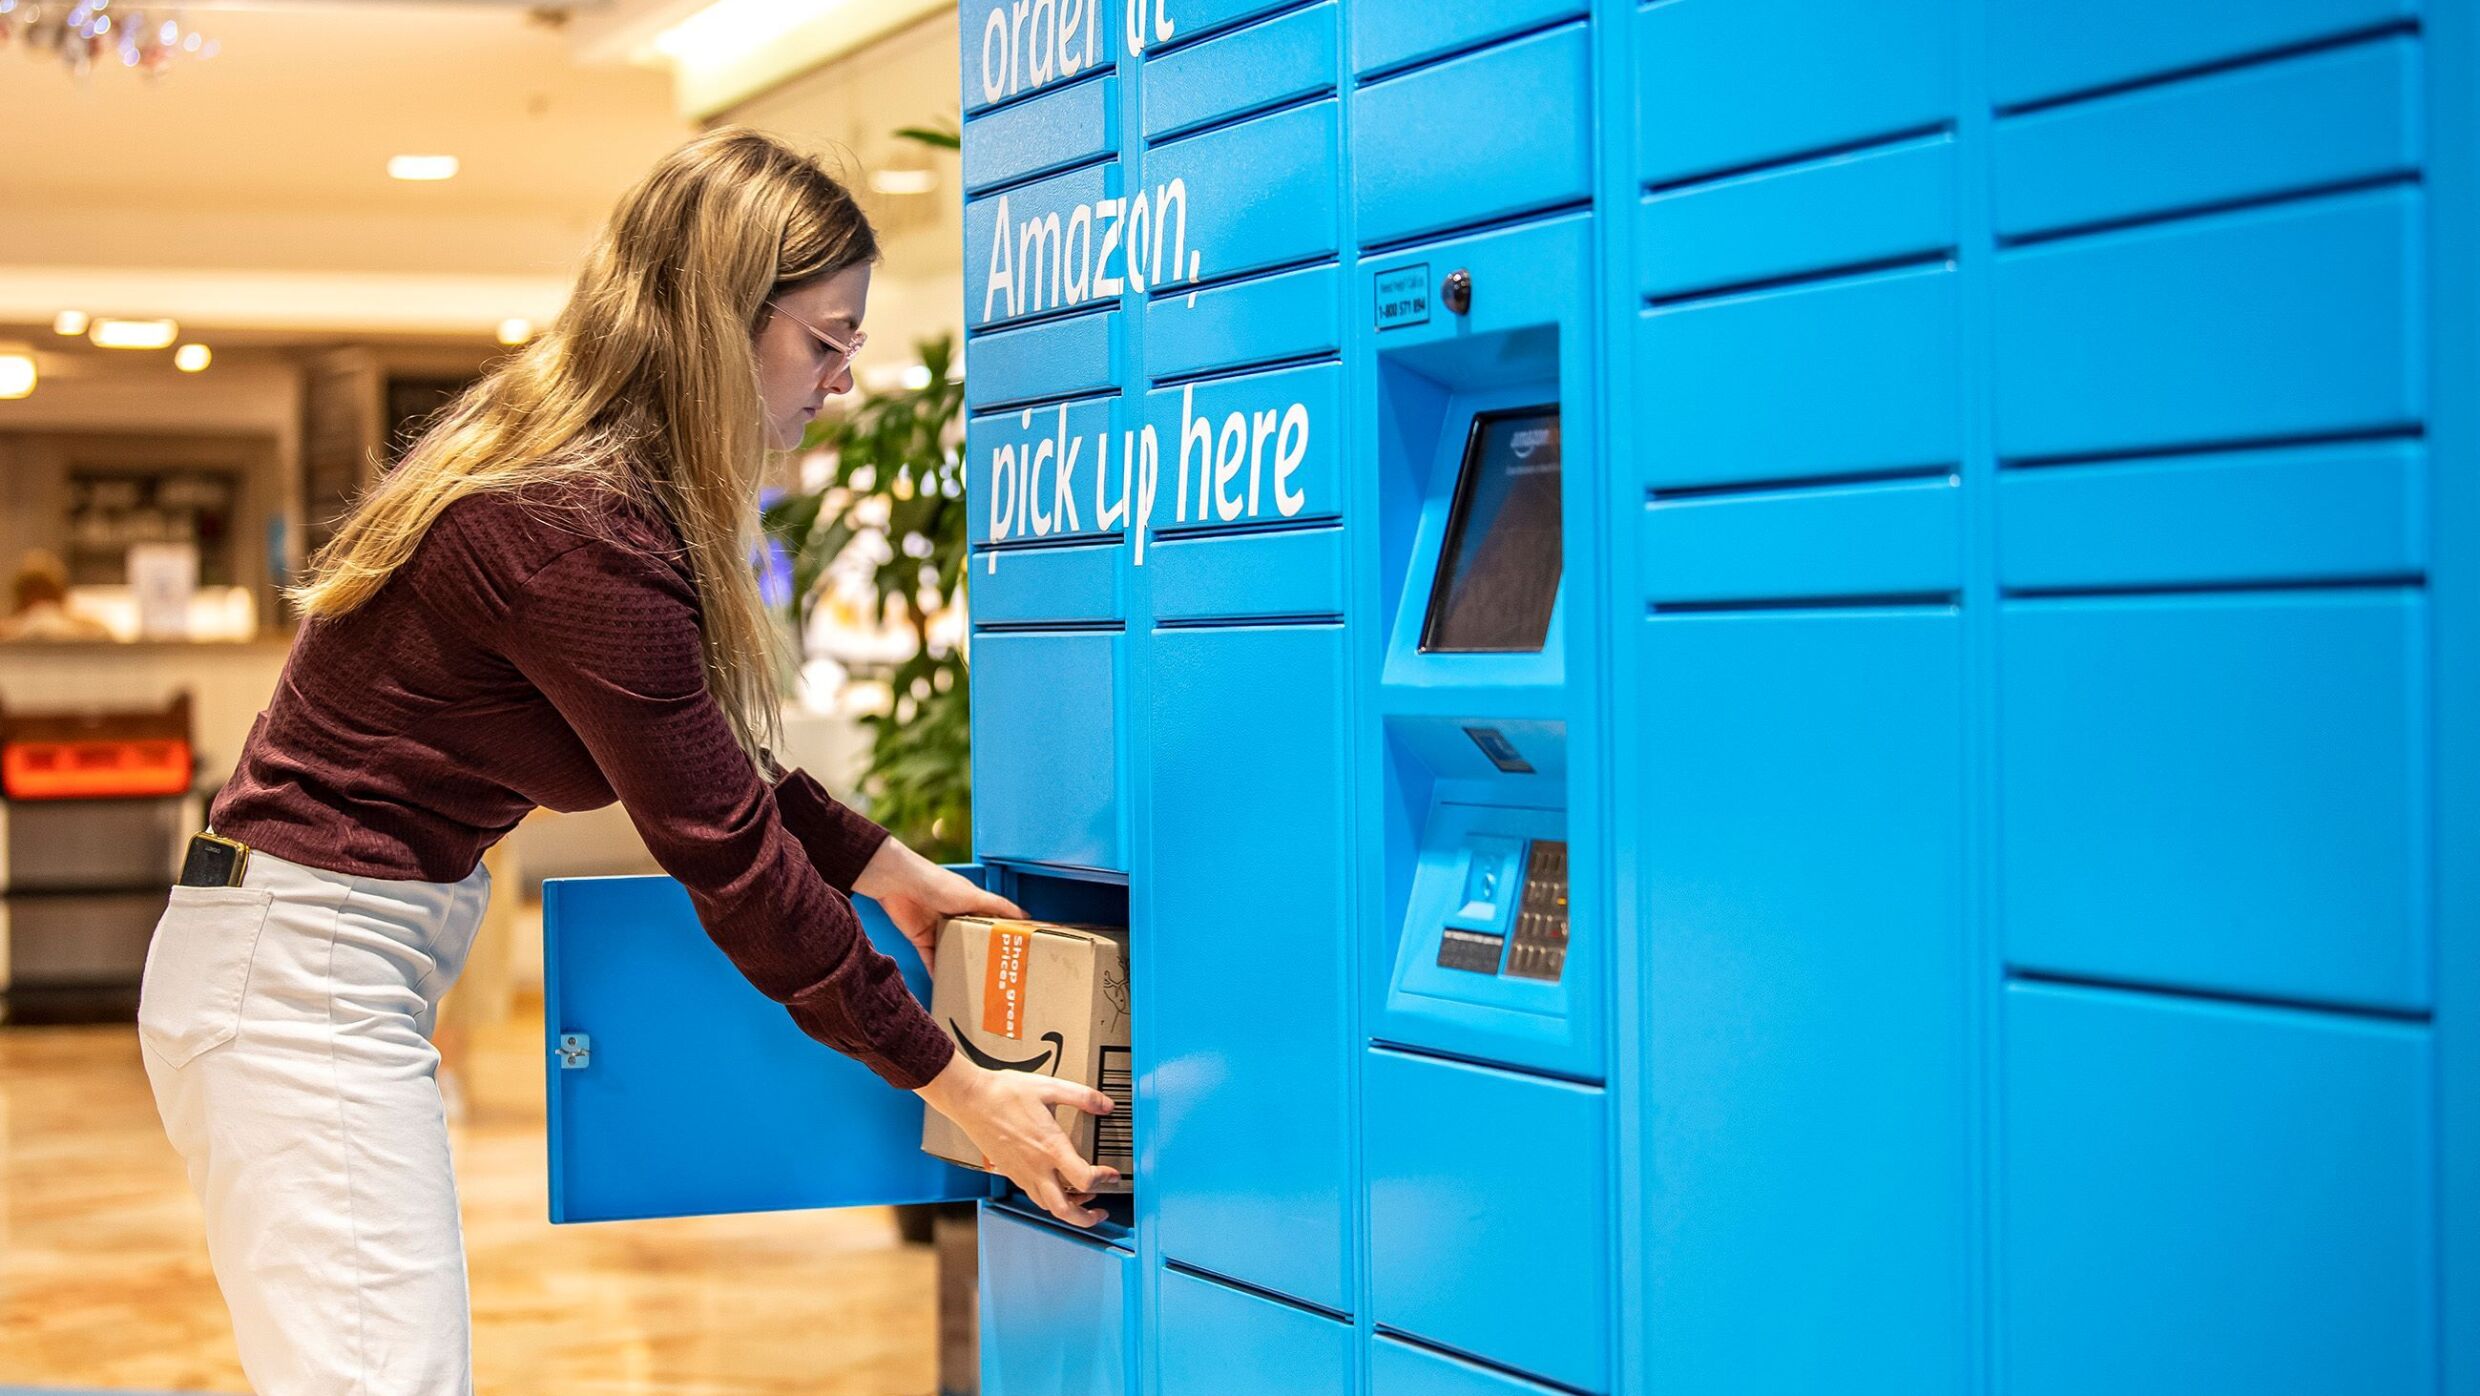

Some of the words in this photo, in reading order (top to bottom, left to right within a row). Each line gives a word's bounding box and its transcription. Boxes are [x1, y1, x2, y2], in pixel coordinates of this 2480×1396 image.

[983, 177, 1200, 323] Amazon,
[988, 402, 1083, 575] pick
[1096, 424, 1158, 566] up
[1176, 383, 1309, 523] here
[999, 933, 1011, 989] prices
[1009, 935, 1023, 983] Shop
[1006, 989, 1016, 1039] great
